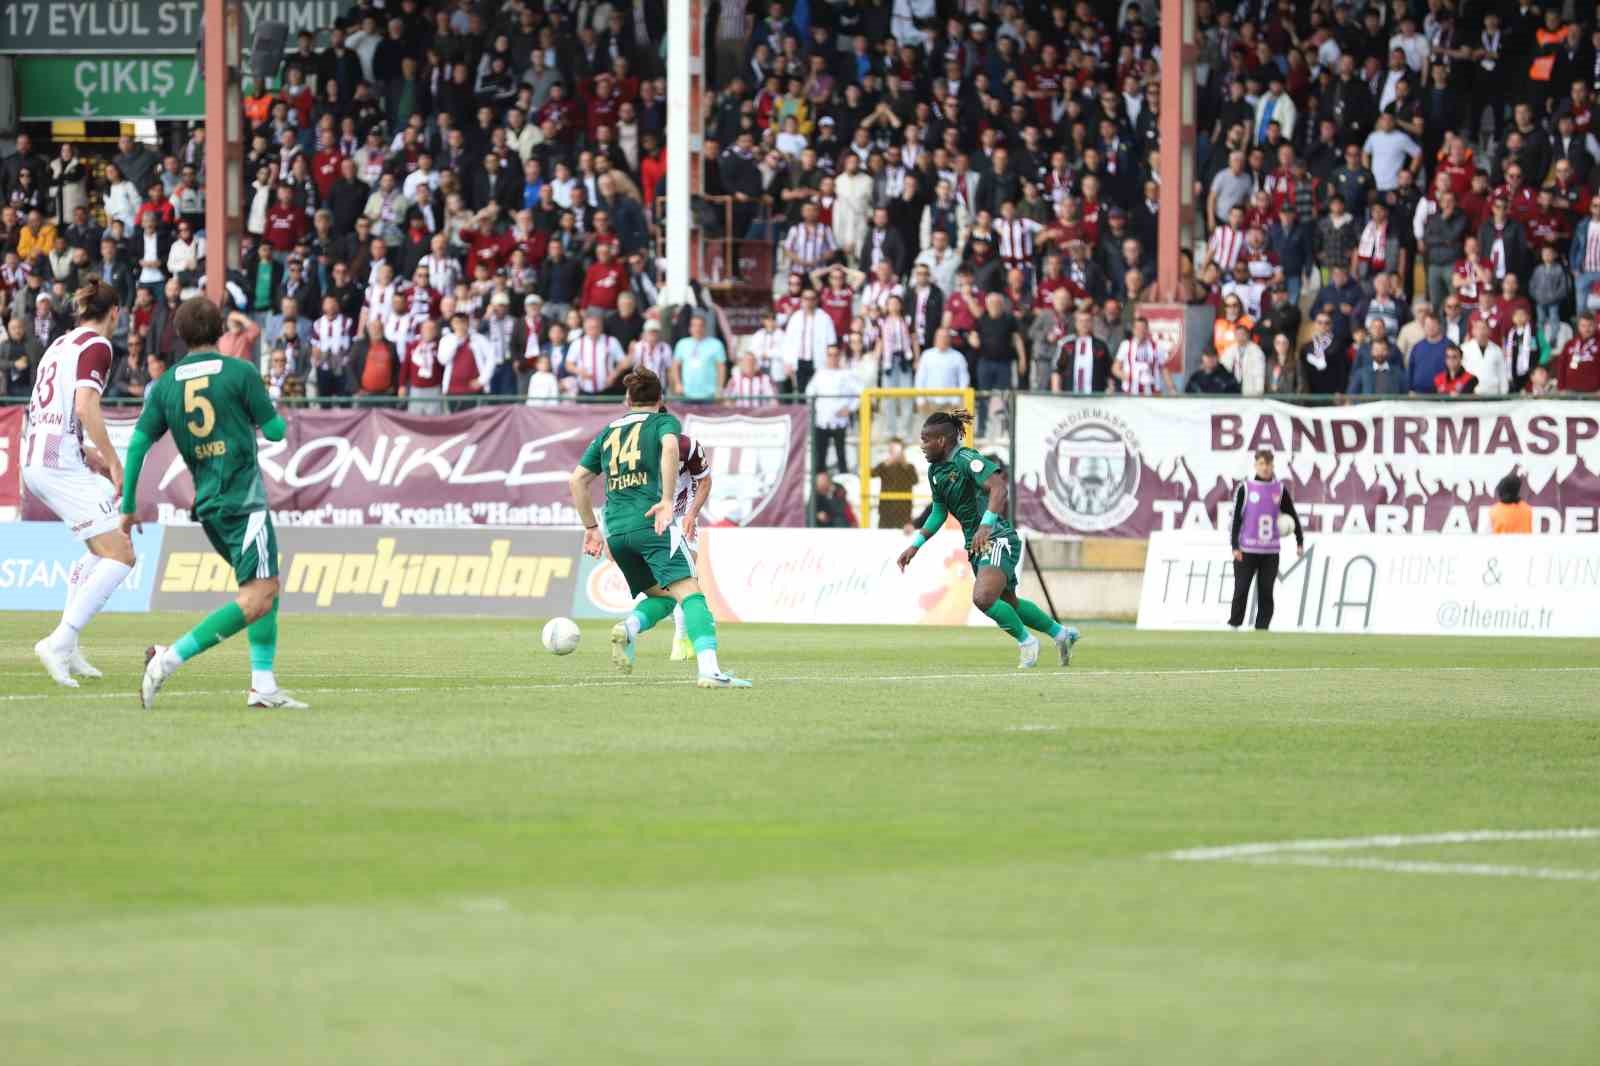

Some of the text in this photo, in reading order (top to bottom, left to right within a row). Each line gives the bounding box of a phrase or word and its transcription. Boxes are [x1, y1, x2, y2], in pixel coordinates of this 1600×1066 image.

[6, 3, 39, 36] 17
[49, 0, 150, 36] EYLÜL
[74, 61, 175, 98] ÇIKIŞ
[184, 376, 215, 438] 5
[603, 423, 642, 476] 14
[1258, 514, 1273, 541] 8
[1533, 506, 1600, 533] DE
[283, 538, 572, 608] makinalar
[1161, 559, 1234, 604] THE
[1482, 556, 1502, 587] &
[1436, 601, 1553, 630] @themia.tr
